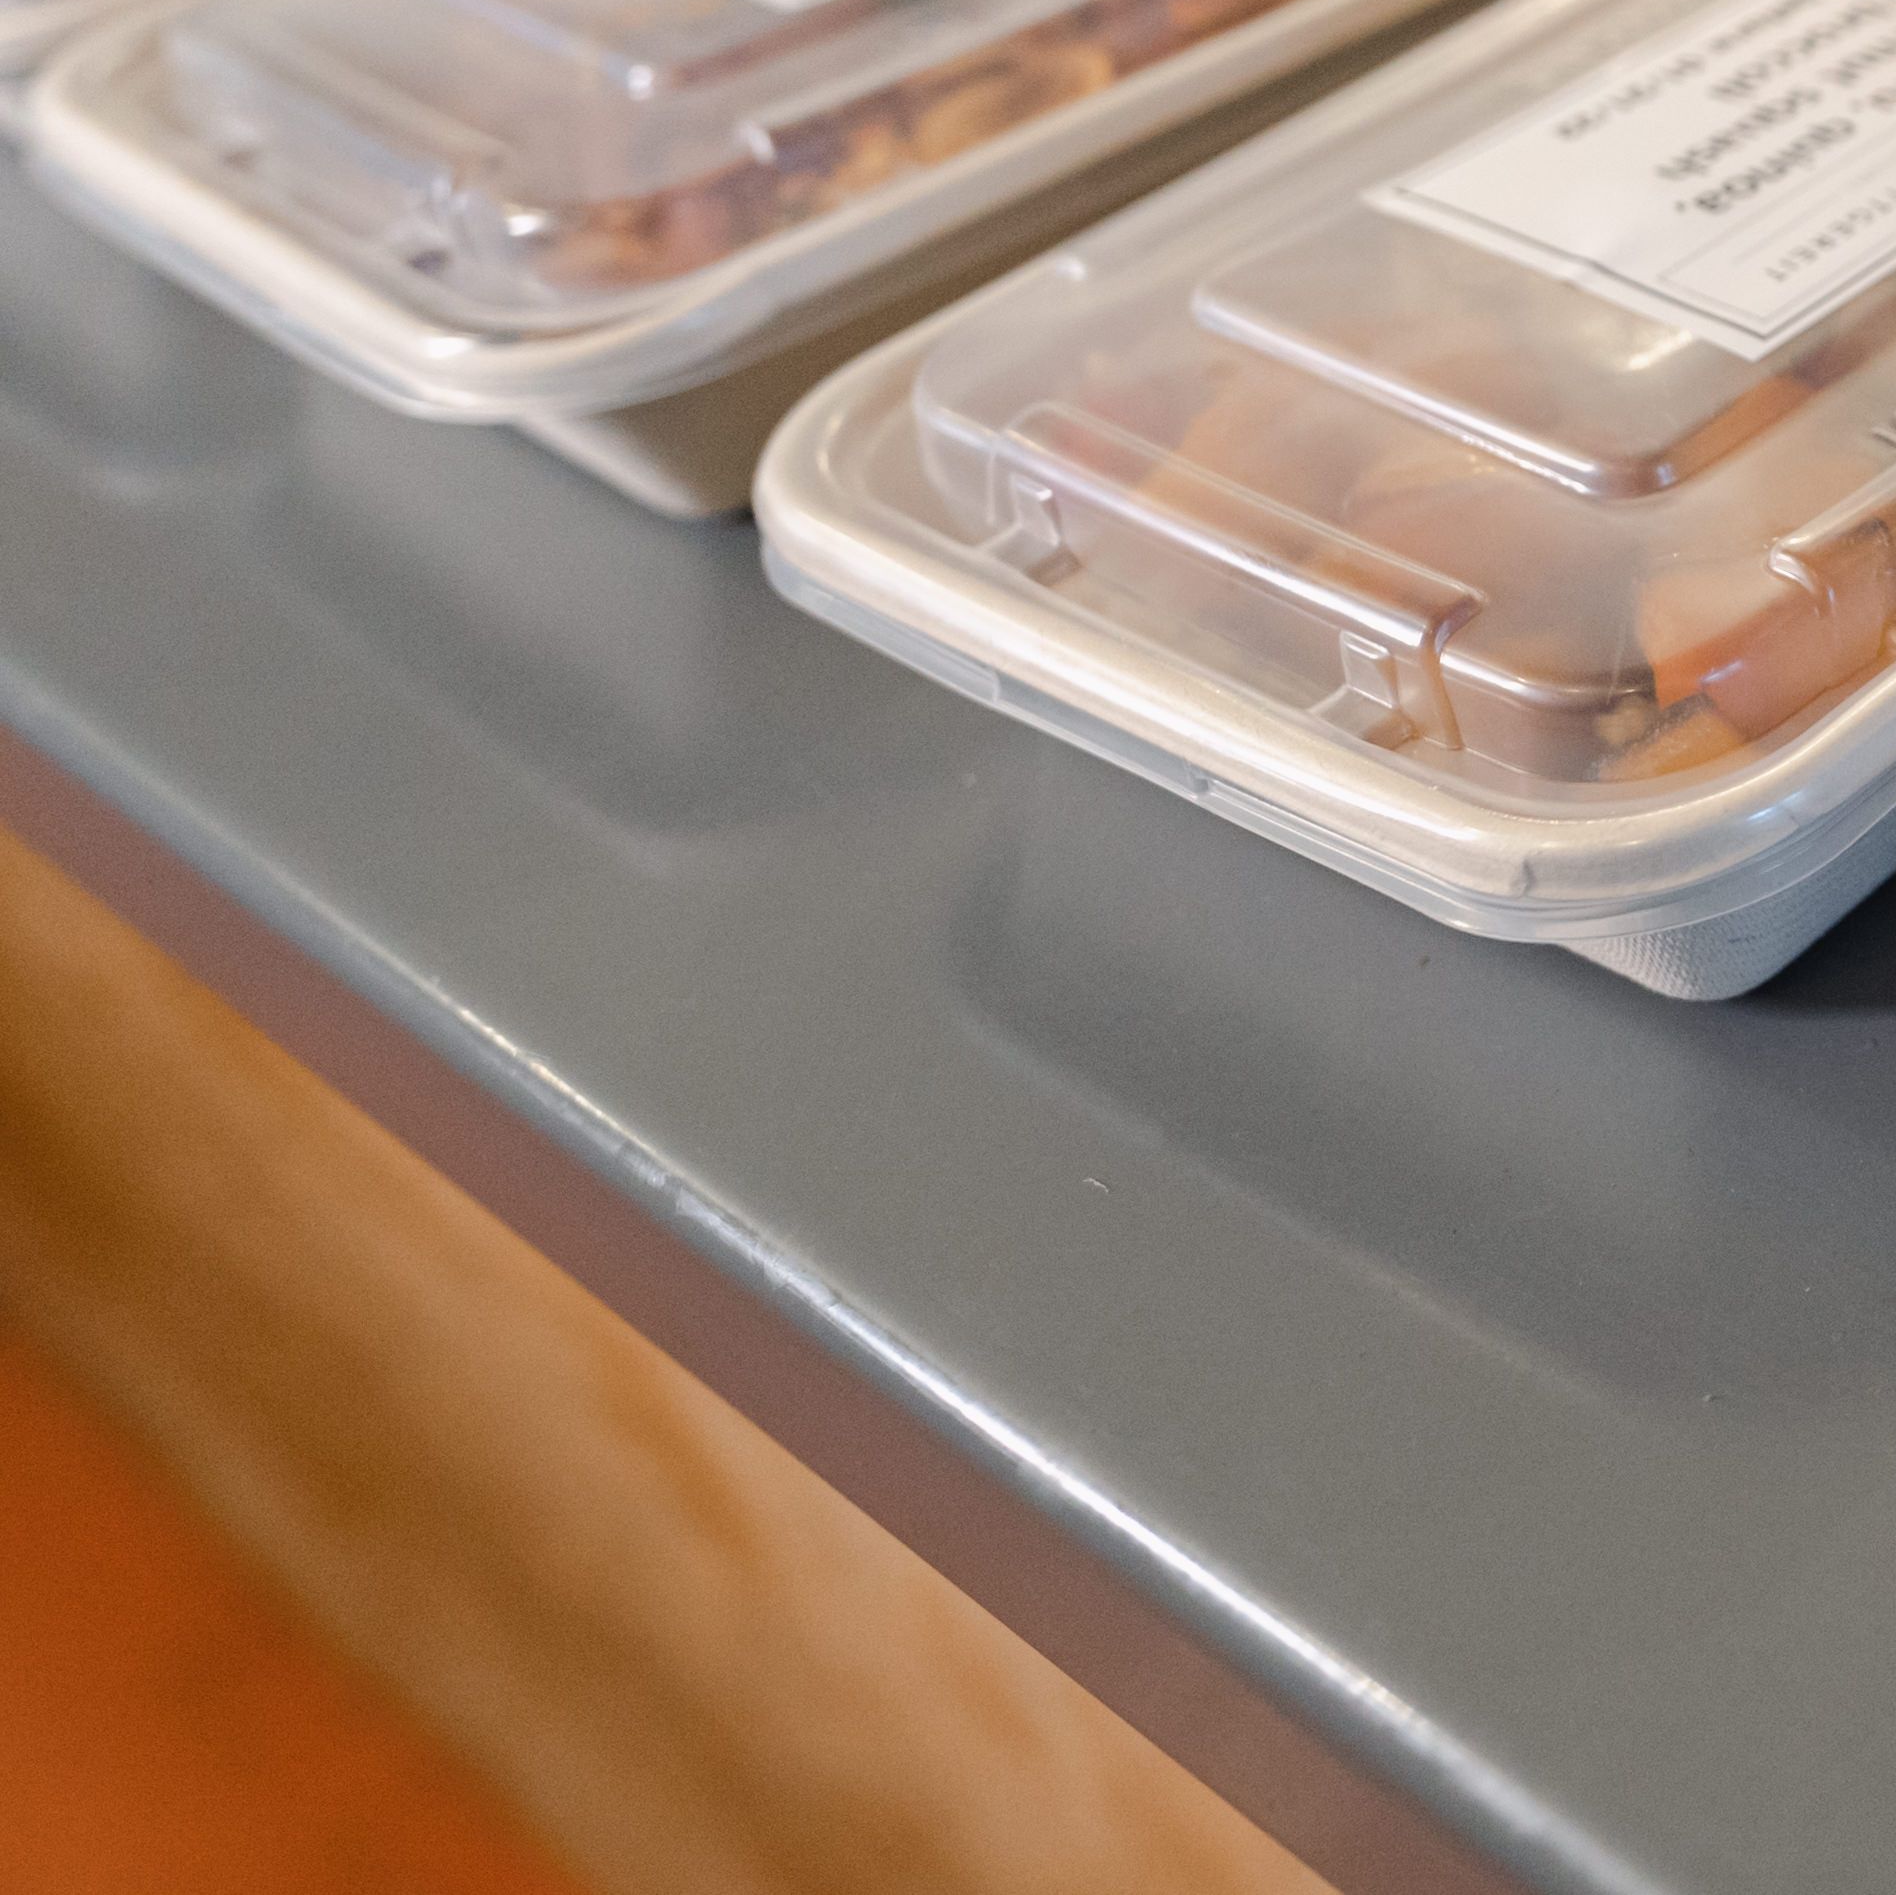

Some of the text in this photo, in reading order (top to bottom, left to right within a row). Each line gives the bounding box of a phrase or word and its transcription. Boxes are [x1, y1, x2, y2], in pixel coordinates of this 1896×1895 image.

[1709, 1, 1890, 104] broccoli
[1654, 89, 1822, 184] squash
[1674, 118, 1855, 217] quinoa,
